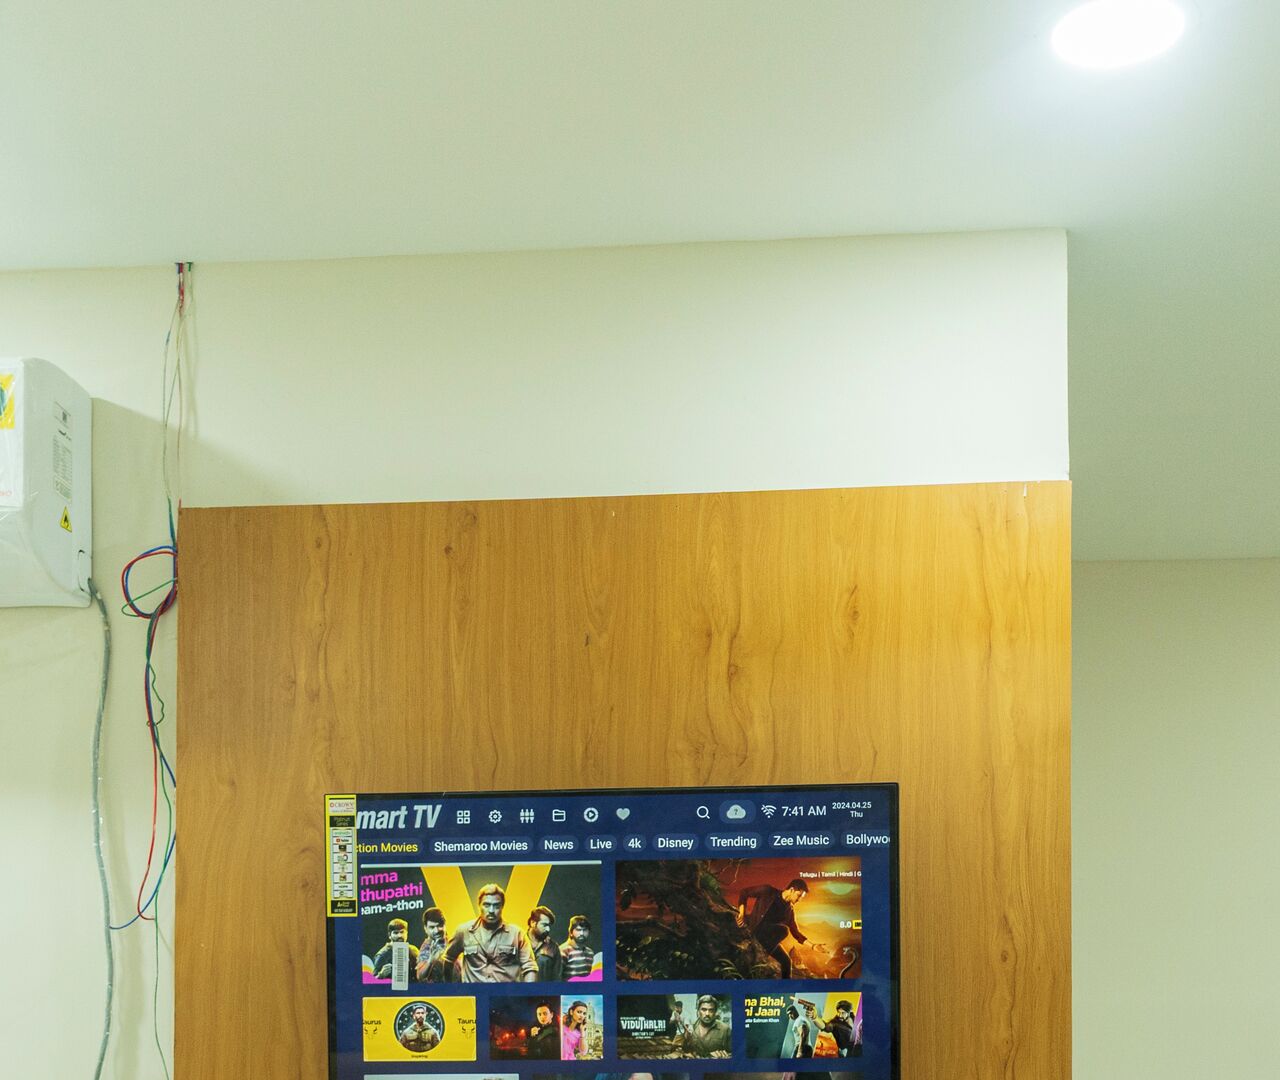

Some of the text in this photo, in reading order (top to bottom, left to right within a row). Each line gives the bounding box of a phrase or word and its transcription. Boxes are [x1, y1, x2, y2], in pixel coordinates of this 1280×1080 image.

[781, 805, 827, 817] 7:41 AM
[832, 801, 872, 810] 2024.04.25
[356, 804, 442, 829] mart TV
[850, 810, 863, 818] Thu
[434, 840, 528, 852] Shemaroo Movies
[544, 840, 574, 850] News
[590, 839, 612, 849] Live
[628, 838, 642, 849] 4k
[658, 838, 694, 850] Disney
[711, 836, 757, 848] Trending
[773, 835, 830, 846] Zee Music
[355, 843, 418, 853] ction Movies
[361, 882, 423, 902] thupathi
[760, 996, 785, 1008] Bhai,
[754, 1007, 781, 1017] Jaan
